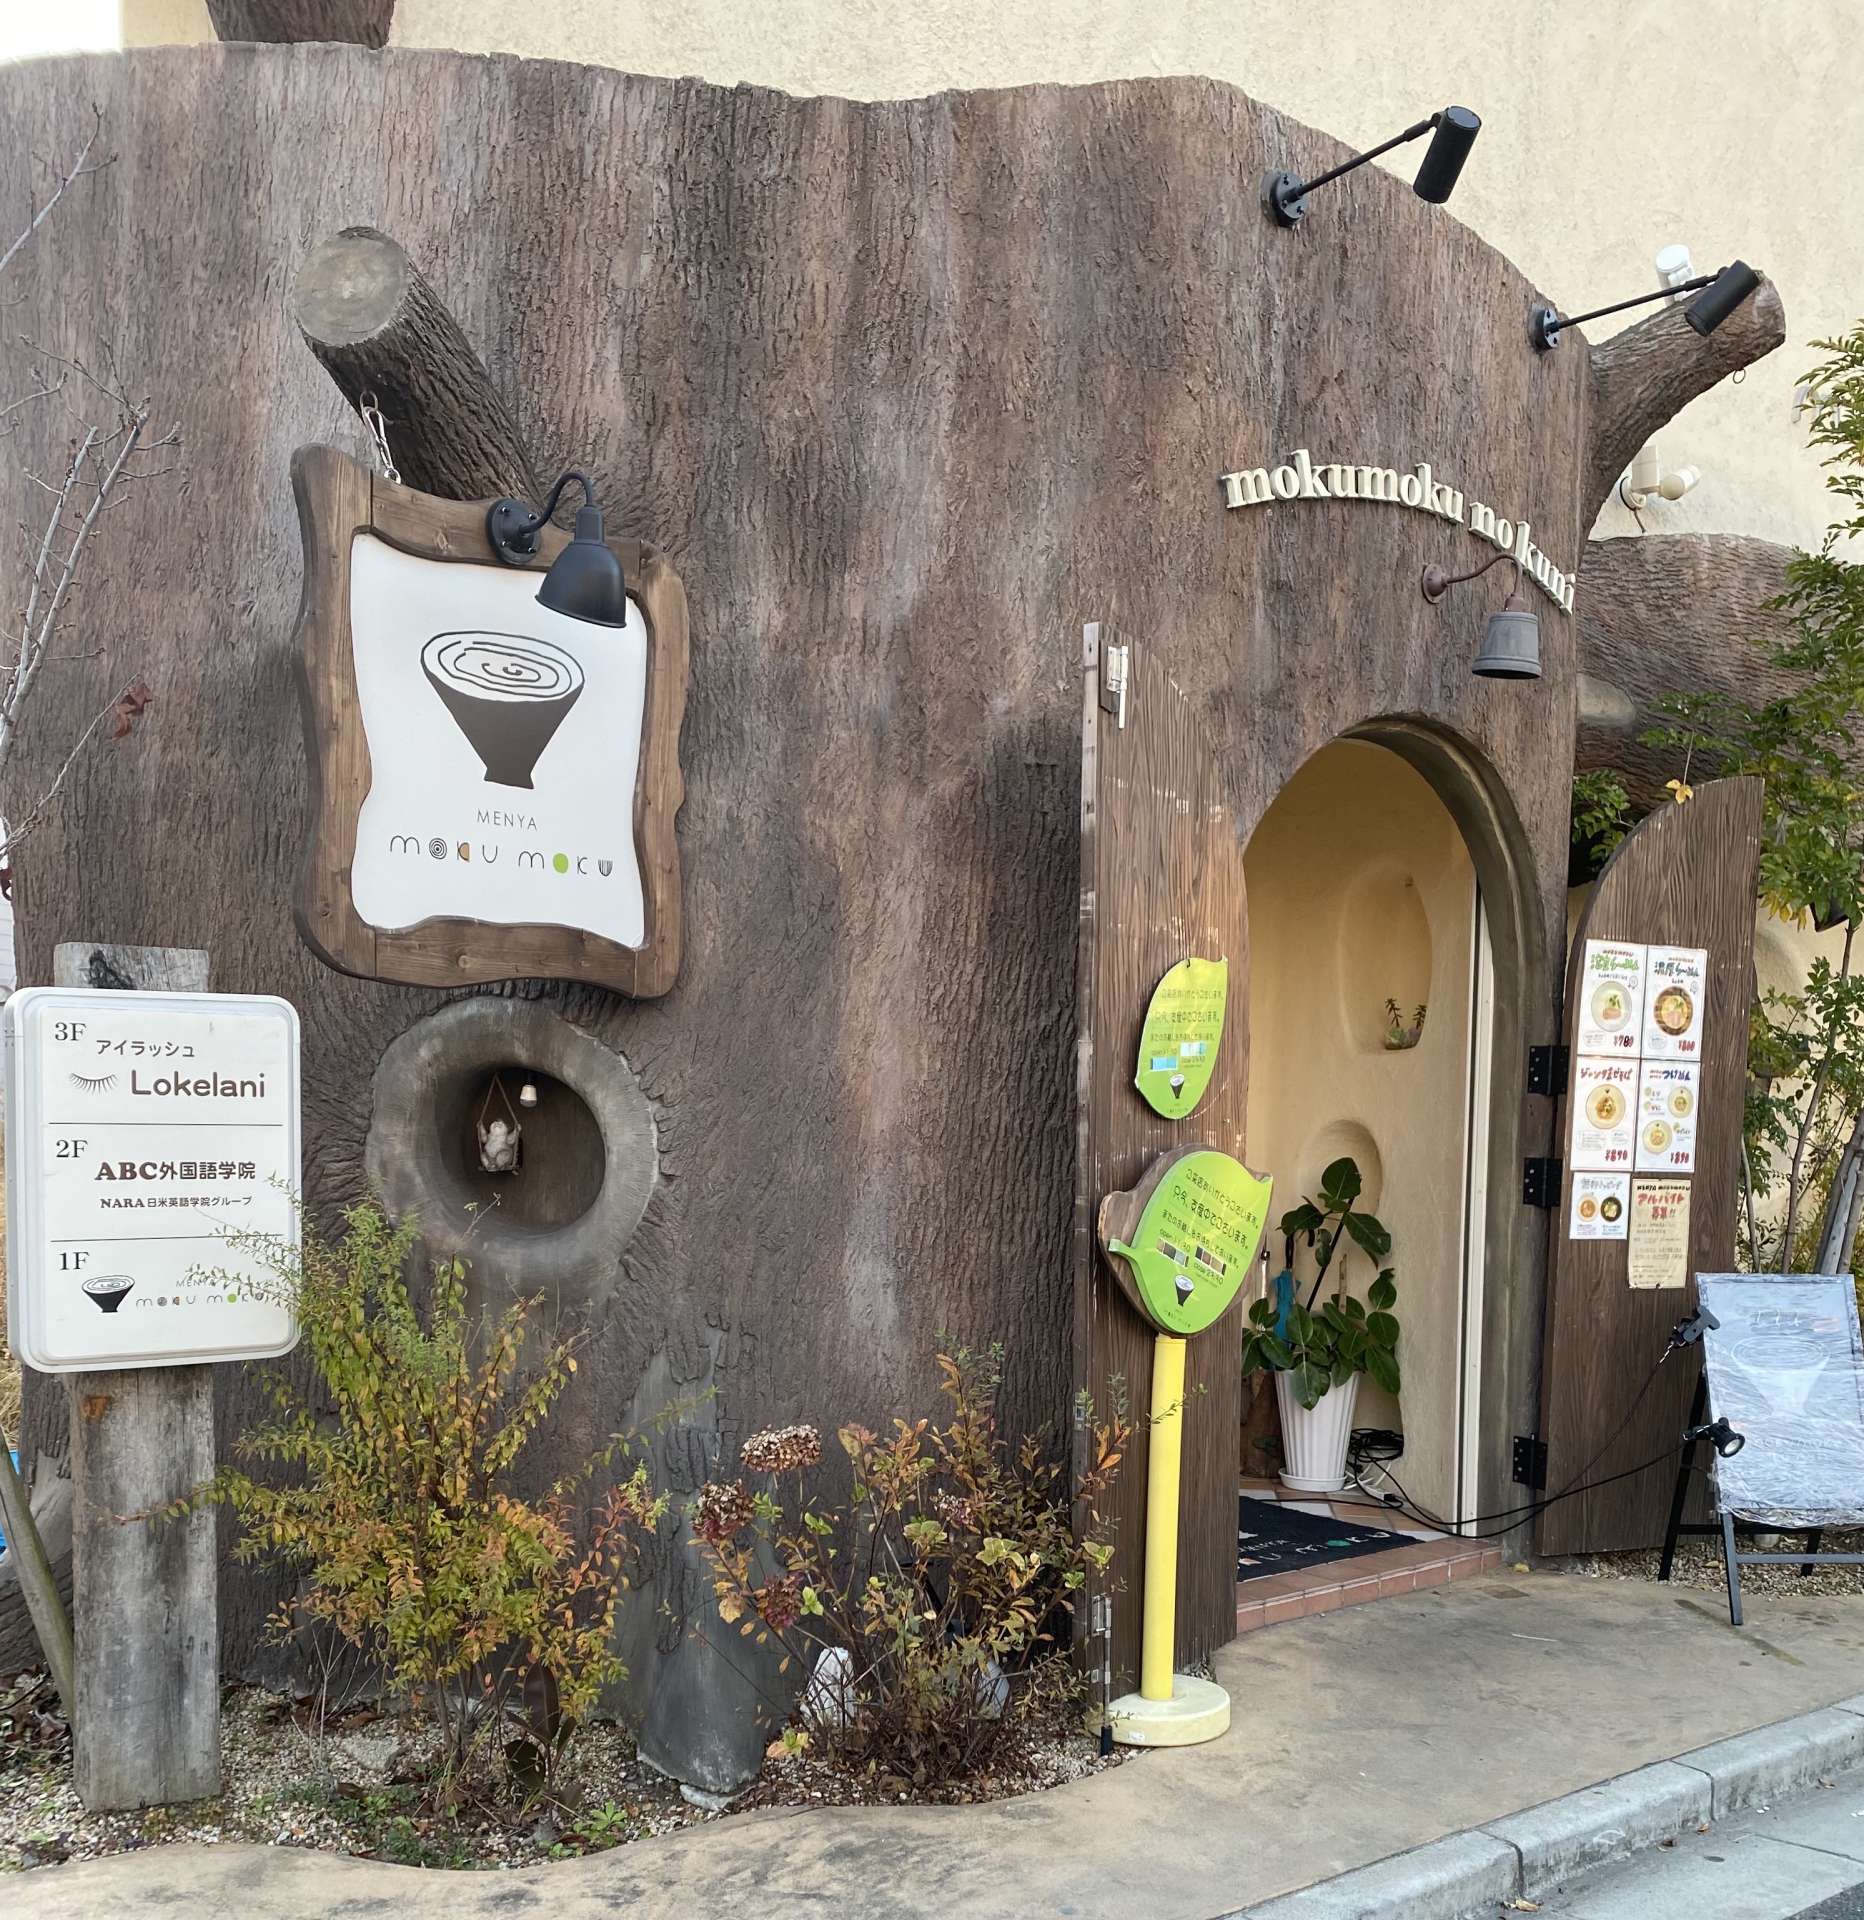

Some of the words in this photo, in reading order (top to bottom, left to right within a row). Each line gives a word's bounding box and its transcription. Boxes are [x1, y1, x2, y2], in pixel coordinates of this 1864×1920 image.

[1221, 449, 1464, 524] mokumoku
[1469, 502, 1513, 550] no
[1513, 520, 1575, 616] kuni
[476, 810, 538, 831] MENYA
[54, 1022, 87, 1042] 3F
[95, 1039, 196, 1058] アイラッシュ
[131, 1069, 266, 1099] Lokelani
[56, 1139, 89, 1159] 2F
[94, 1160, 257, 1182] ABC外国語学院
[59, 1251, 90, 1271] 1F
